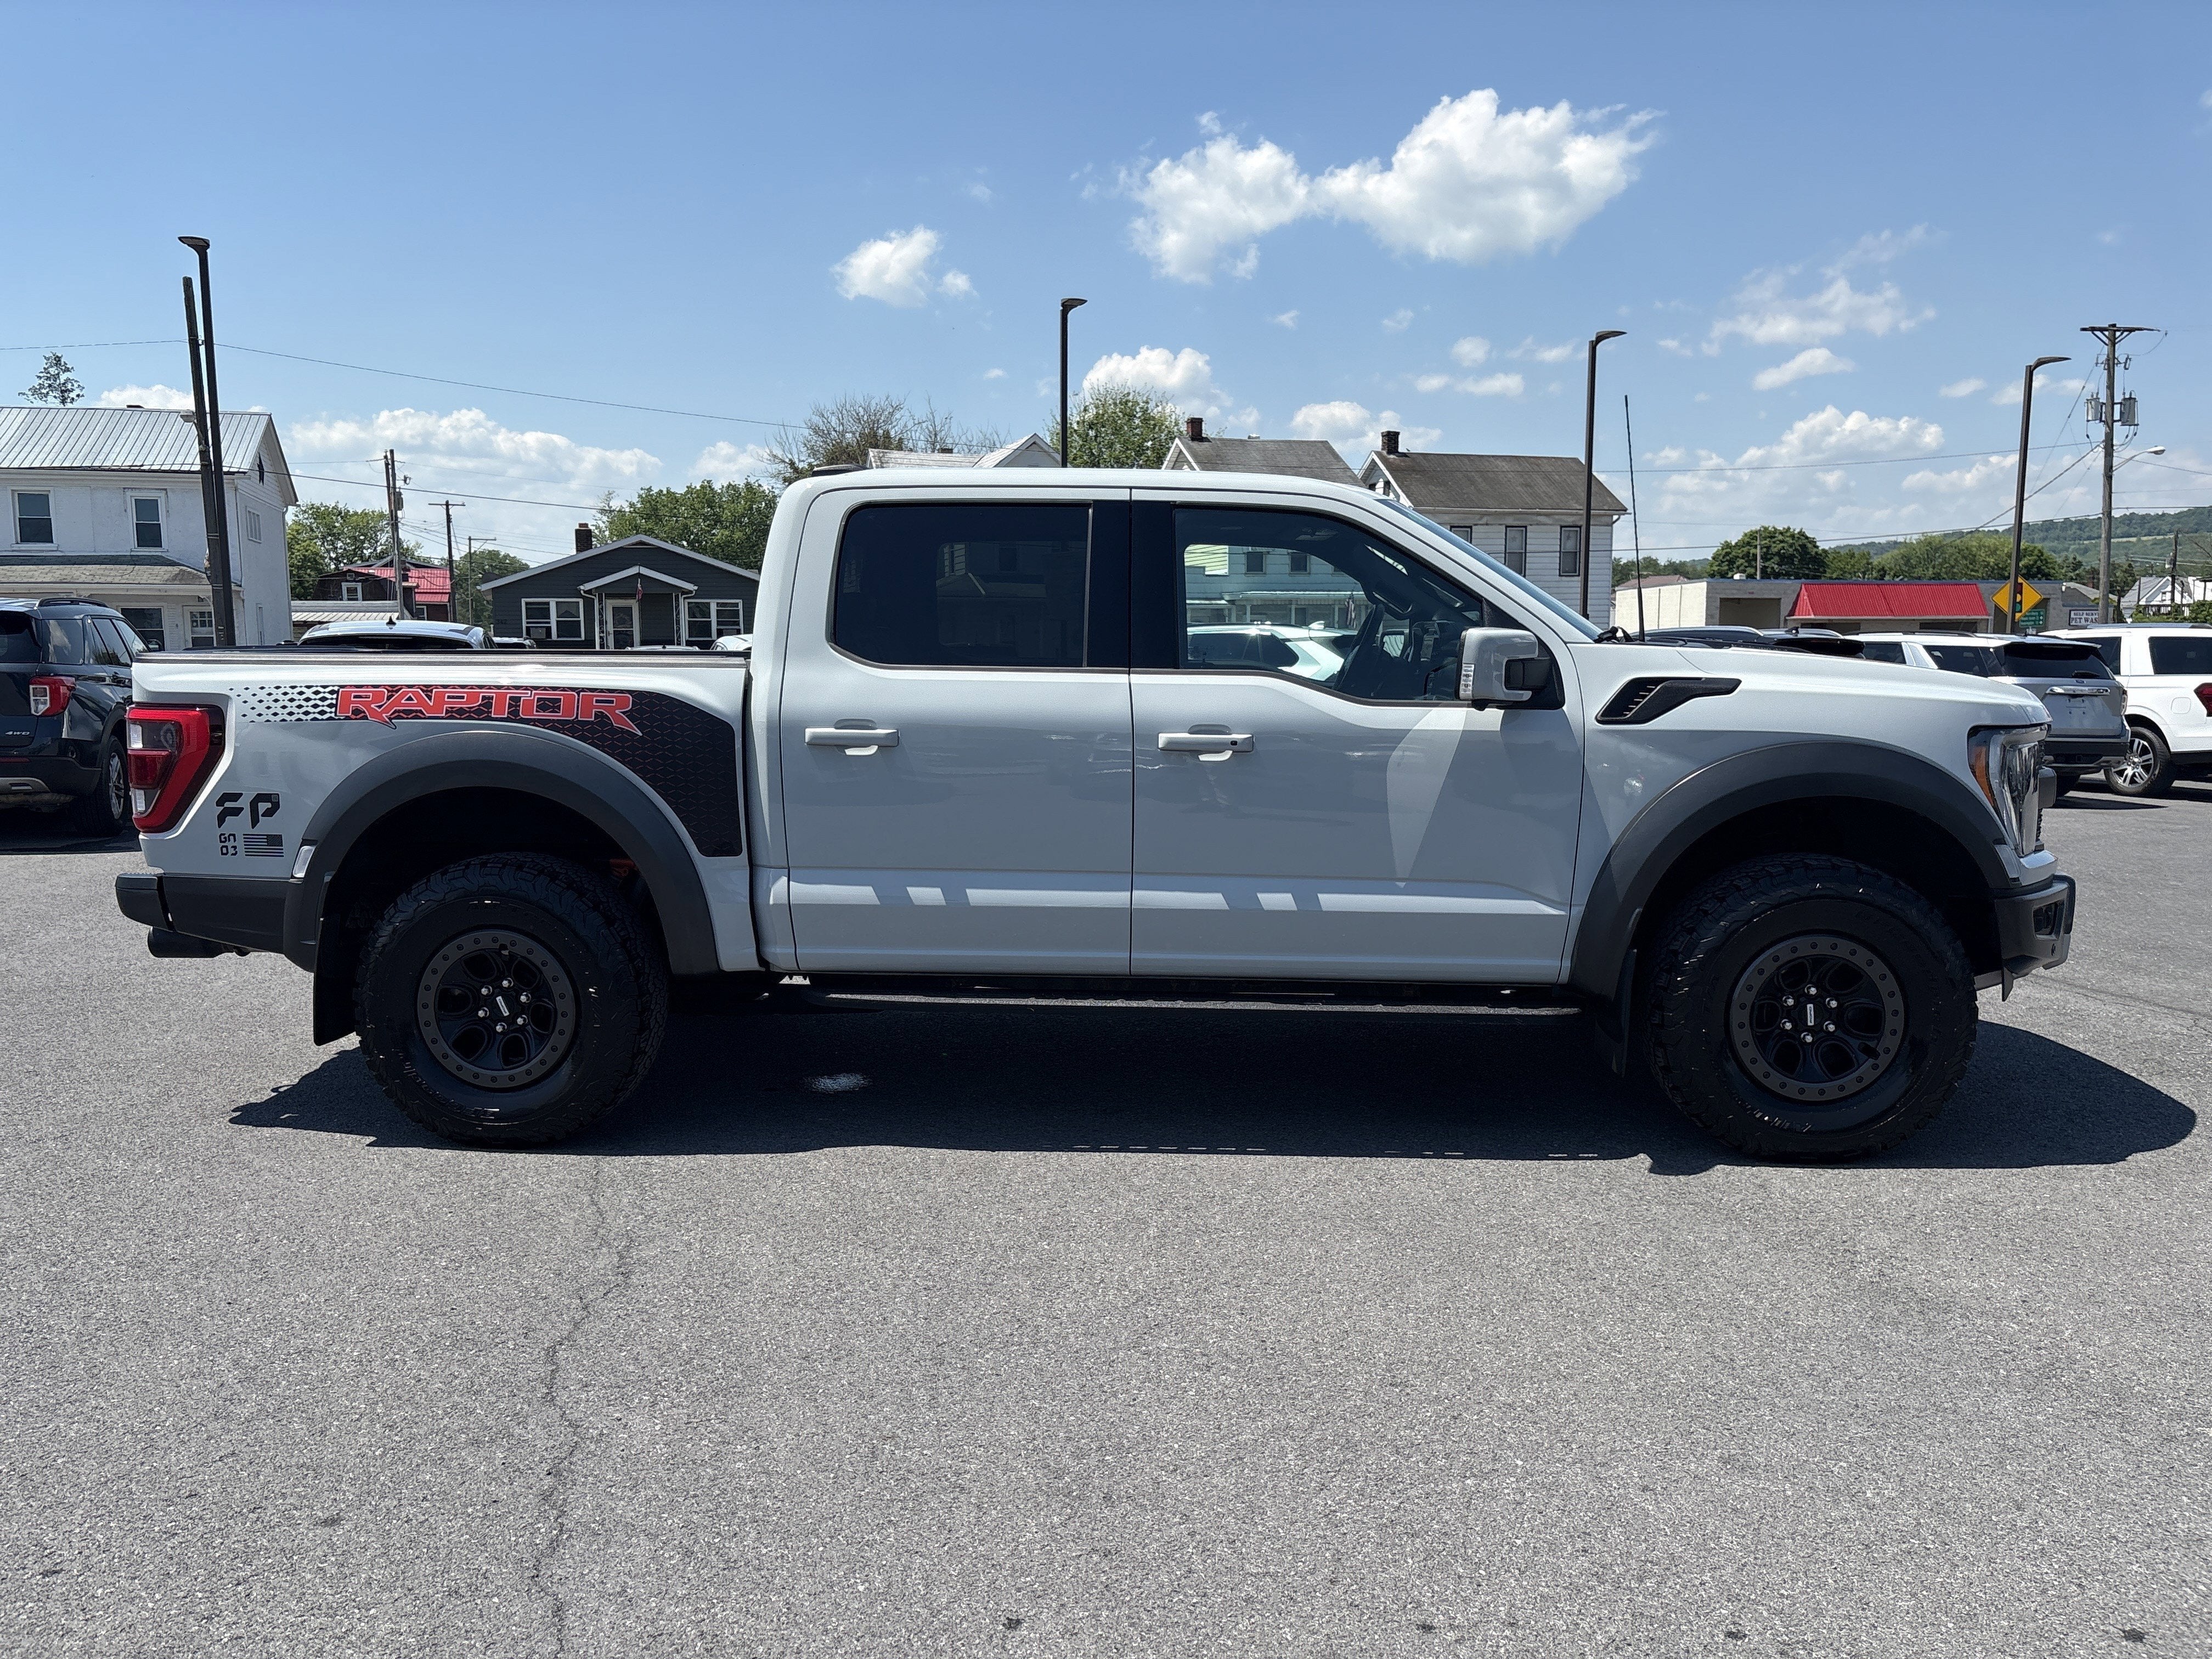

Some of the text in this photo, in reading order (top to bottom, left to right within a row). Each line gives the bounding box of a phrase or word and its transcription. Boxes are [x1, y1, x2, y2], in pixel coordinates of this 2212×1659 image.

[336, 689, 643, 736] RAPTOR
[216, 792, 280, 830] FP
[220, 845, 238, 856] 03
